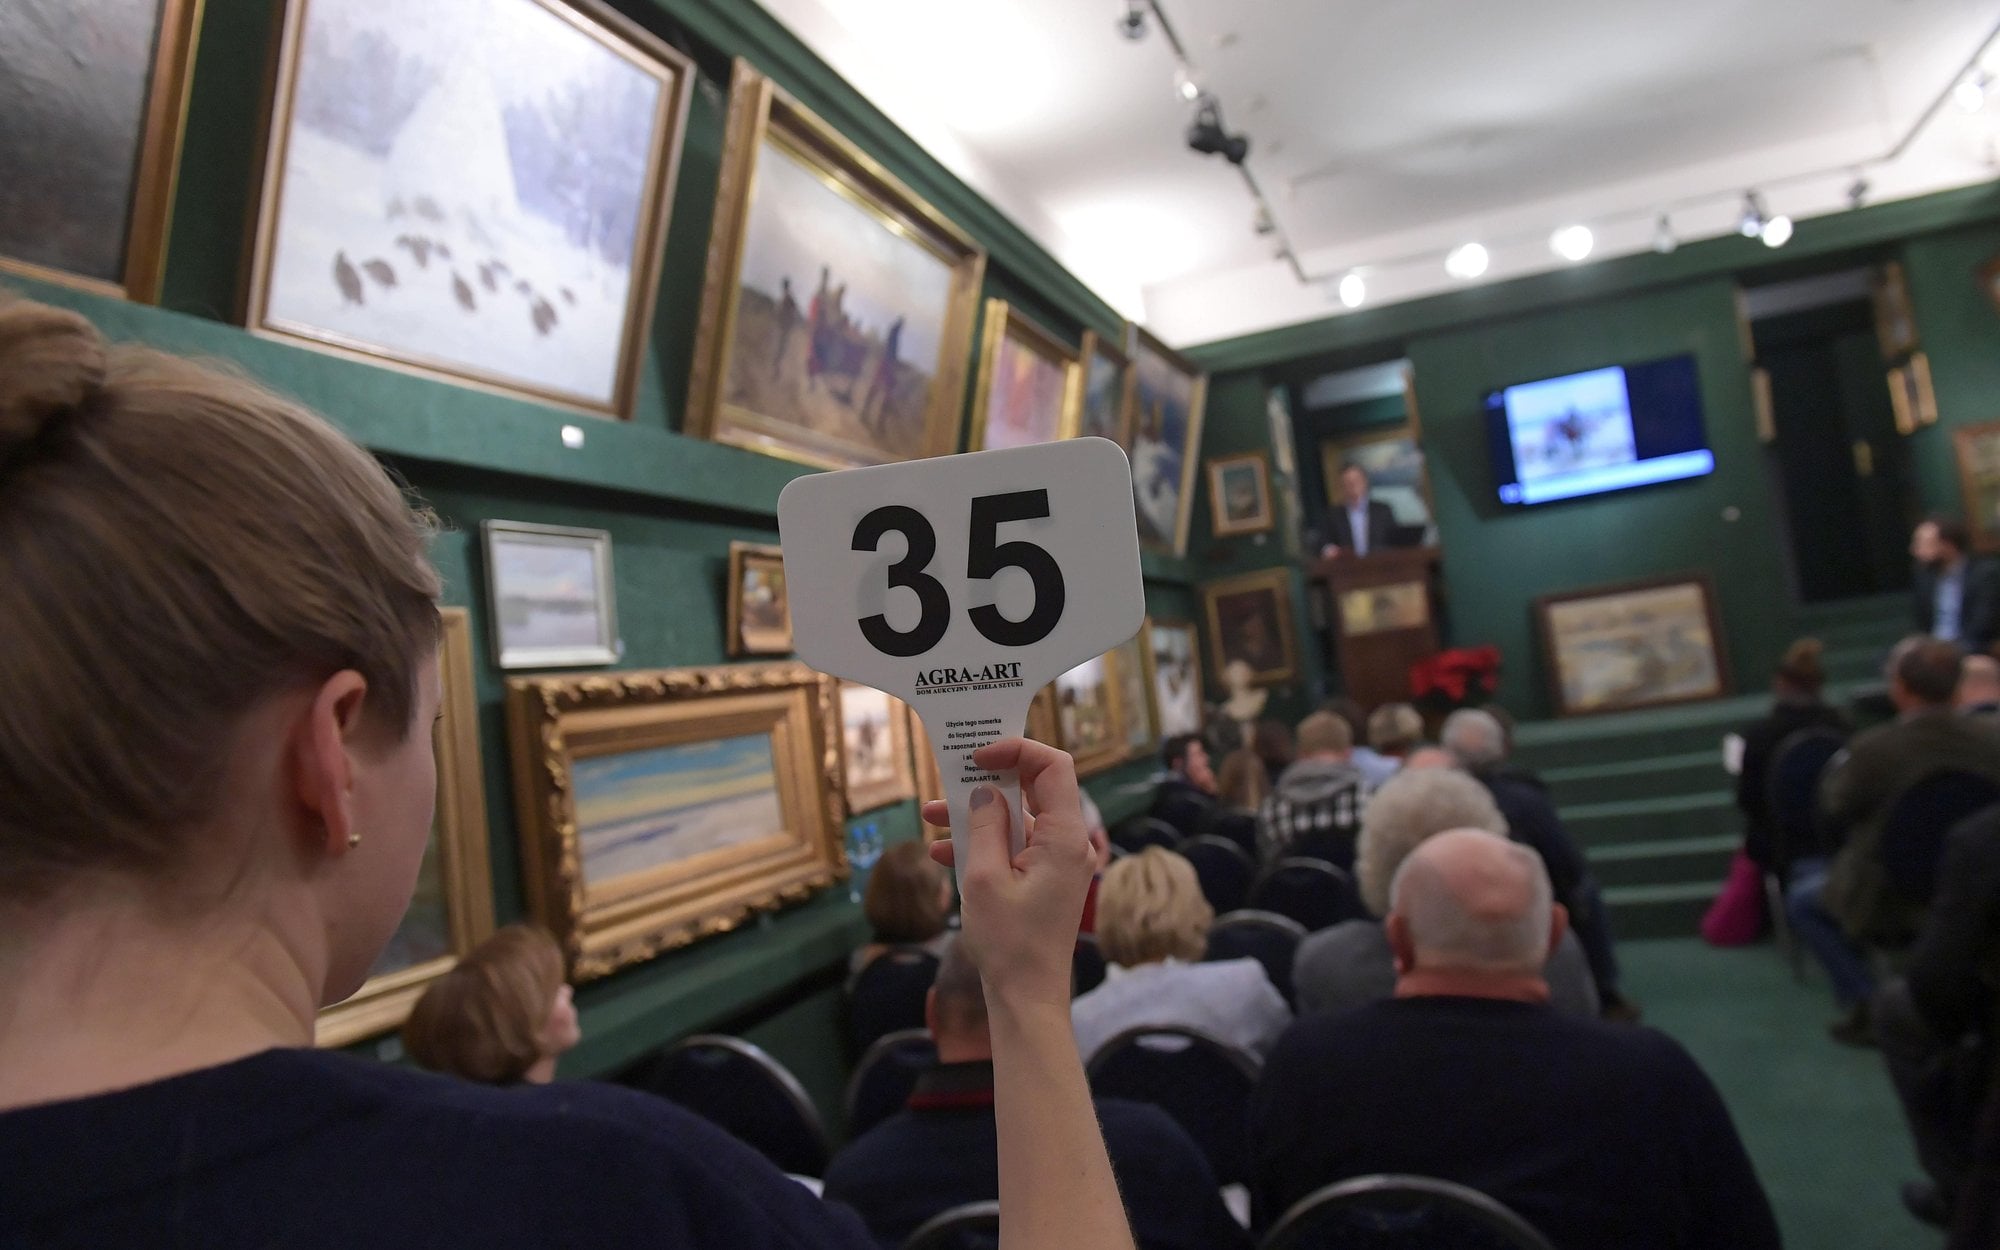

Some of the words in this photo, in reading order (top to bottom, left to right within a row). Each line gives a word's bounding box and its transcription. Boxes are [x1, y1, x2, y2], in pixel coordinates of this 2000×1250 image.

[851, 488, 1065, 657] 35
[915, 662, 1021, 687] AGRA-ART
[998, 681, 1023, 689] SZTUKI
[956, 731, 977, 739] licytacji
